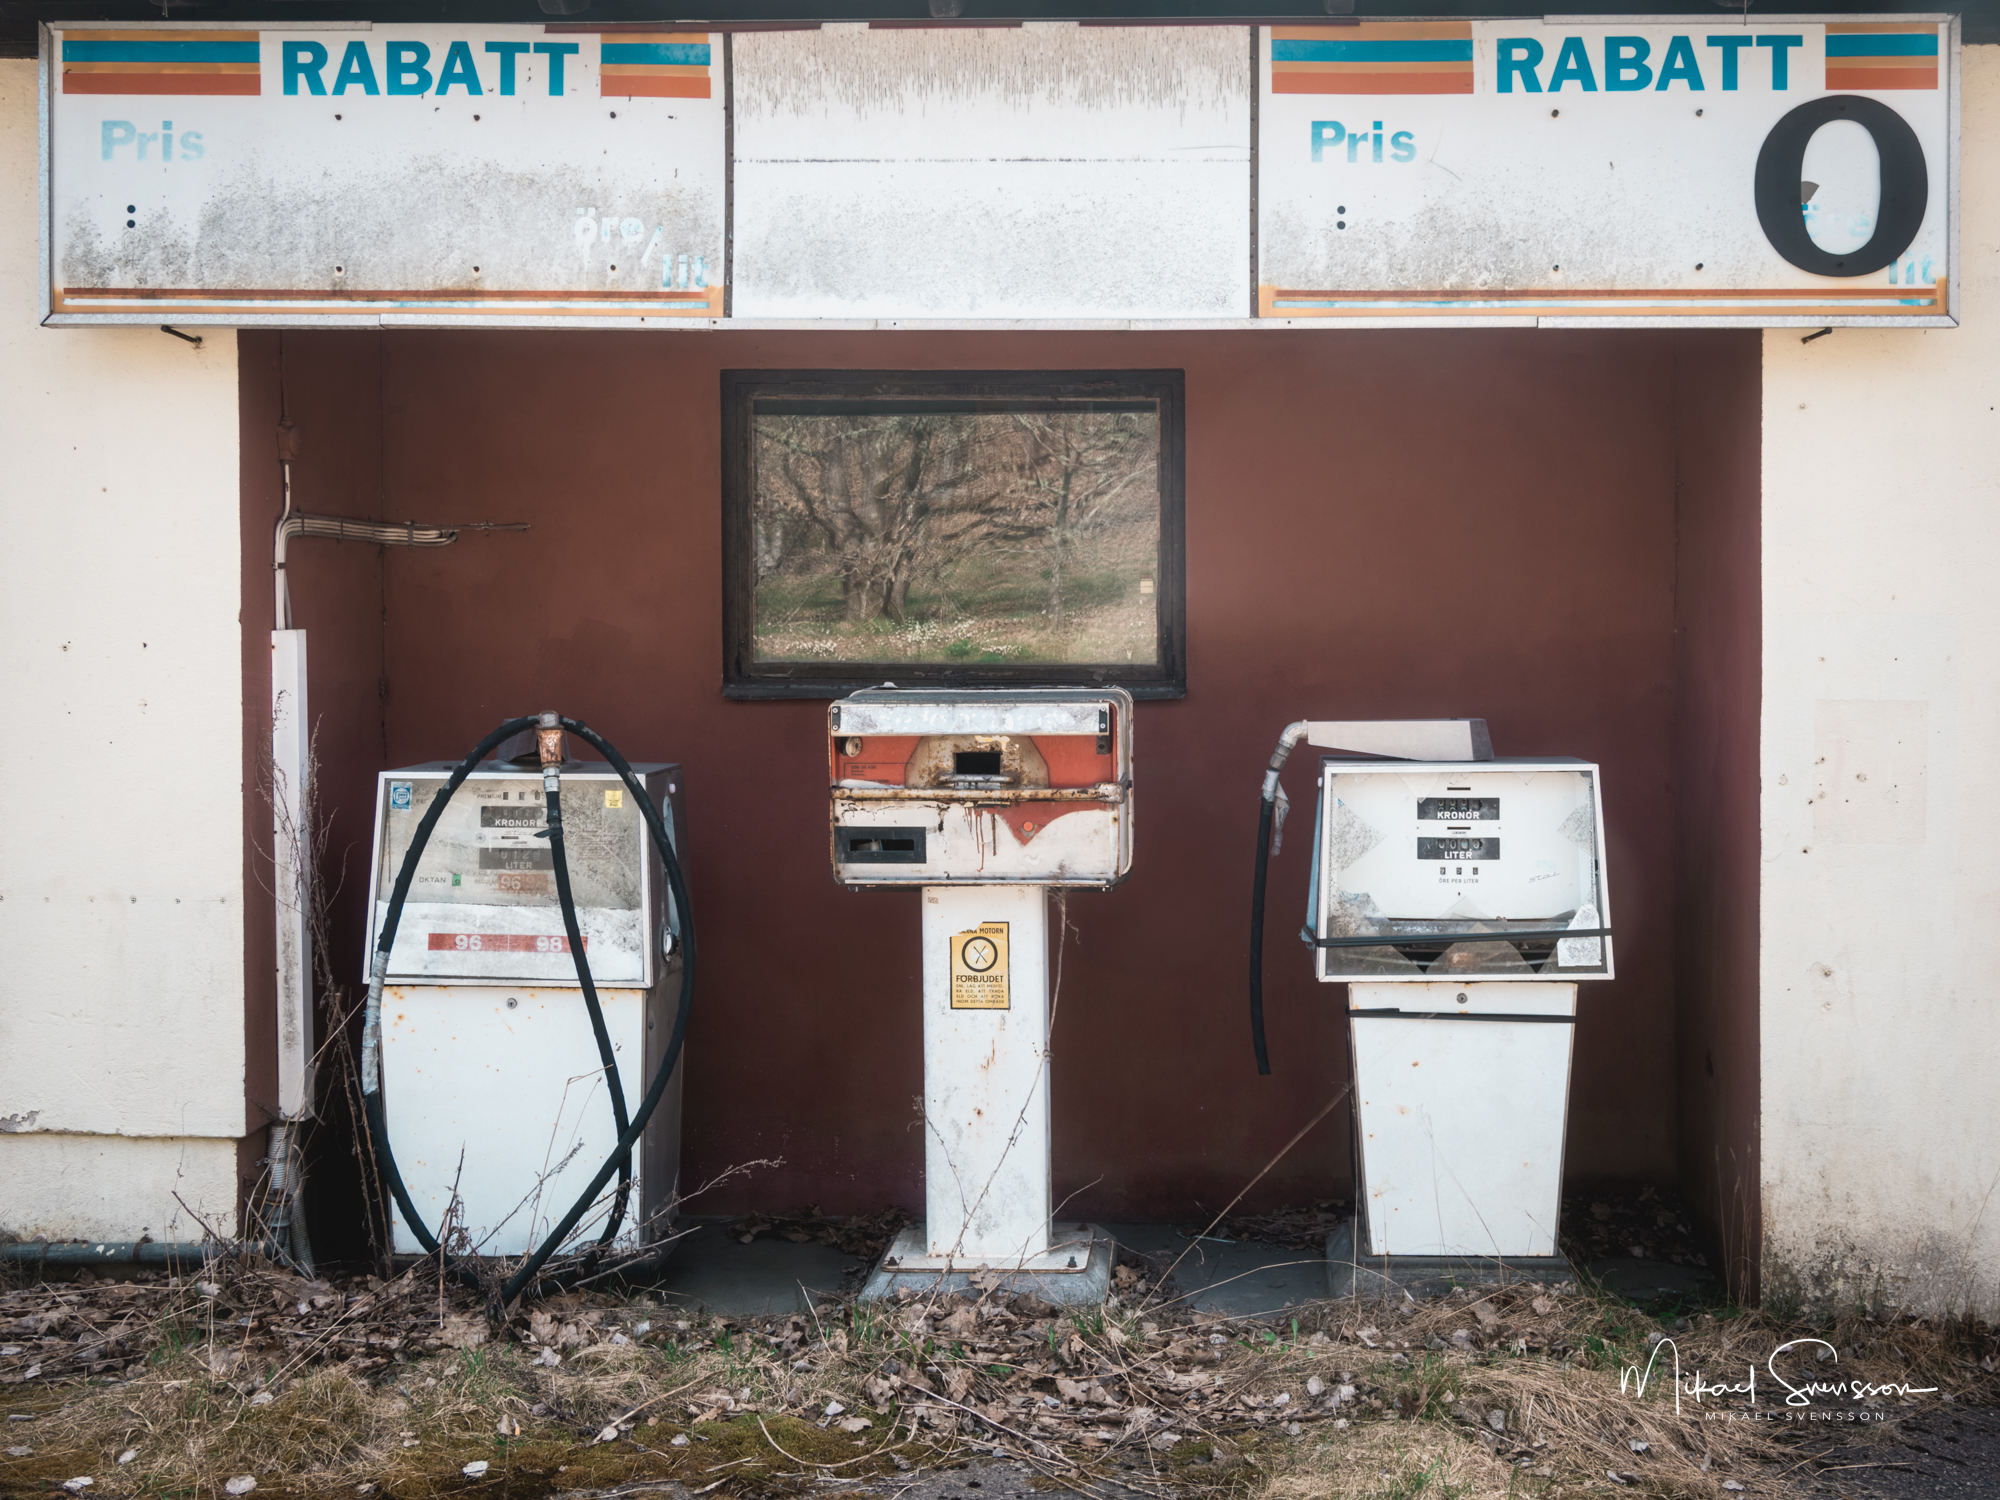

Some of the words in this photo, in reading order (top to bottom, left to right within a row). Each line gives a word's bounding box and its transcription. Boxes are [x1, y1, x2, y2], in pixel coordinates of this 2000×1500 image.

[282, 40, 580, 96] RABATT
[1496, 35, 1803, 93] RABATT
[102, 120, 205, 162] Pris
[1311, 121, 1417, 163] Pris
[662, 254, 709, 288] lit
[495, 819, 536, 827] KRONOR
[1437, 811, 1480, 820] KRONOR
[1444, 851, 1473, 859] LITER
[505, 861, 533, 869] LITER
[501, 875, 521, 890] 96
[455, 935, 482, 951] 96
[536, 936, 562, 952] 98
